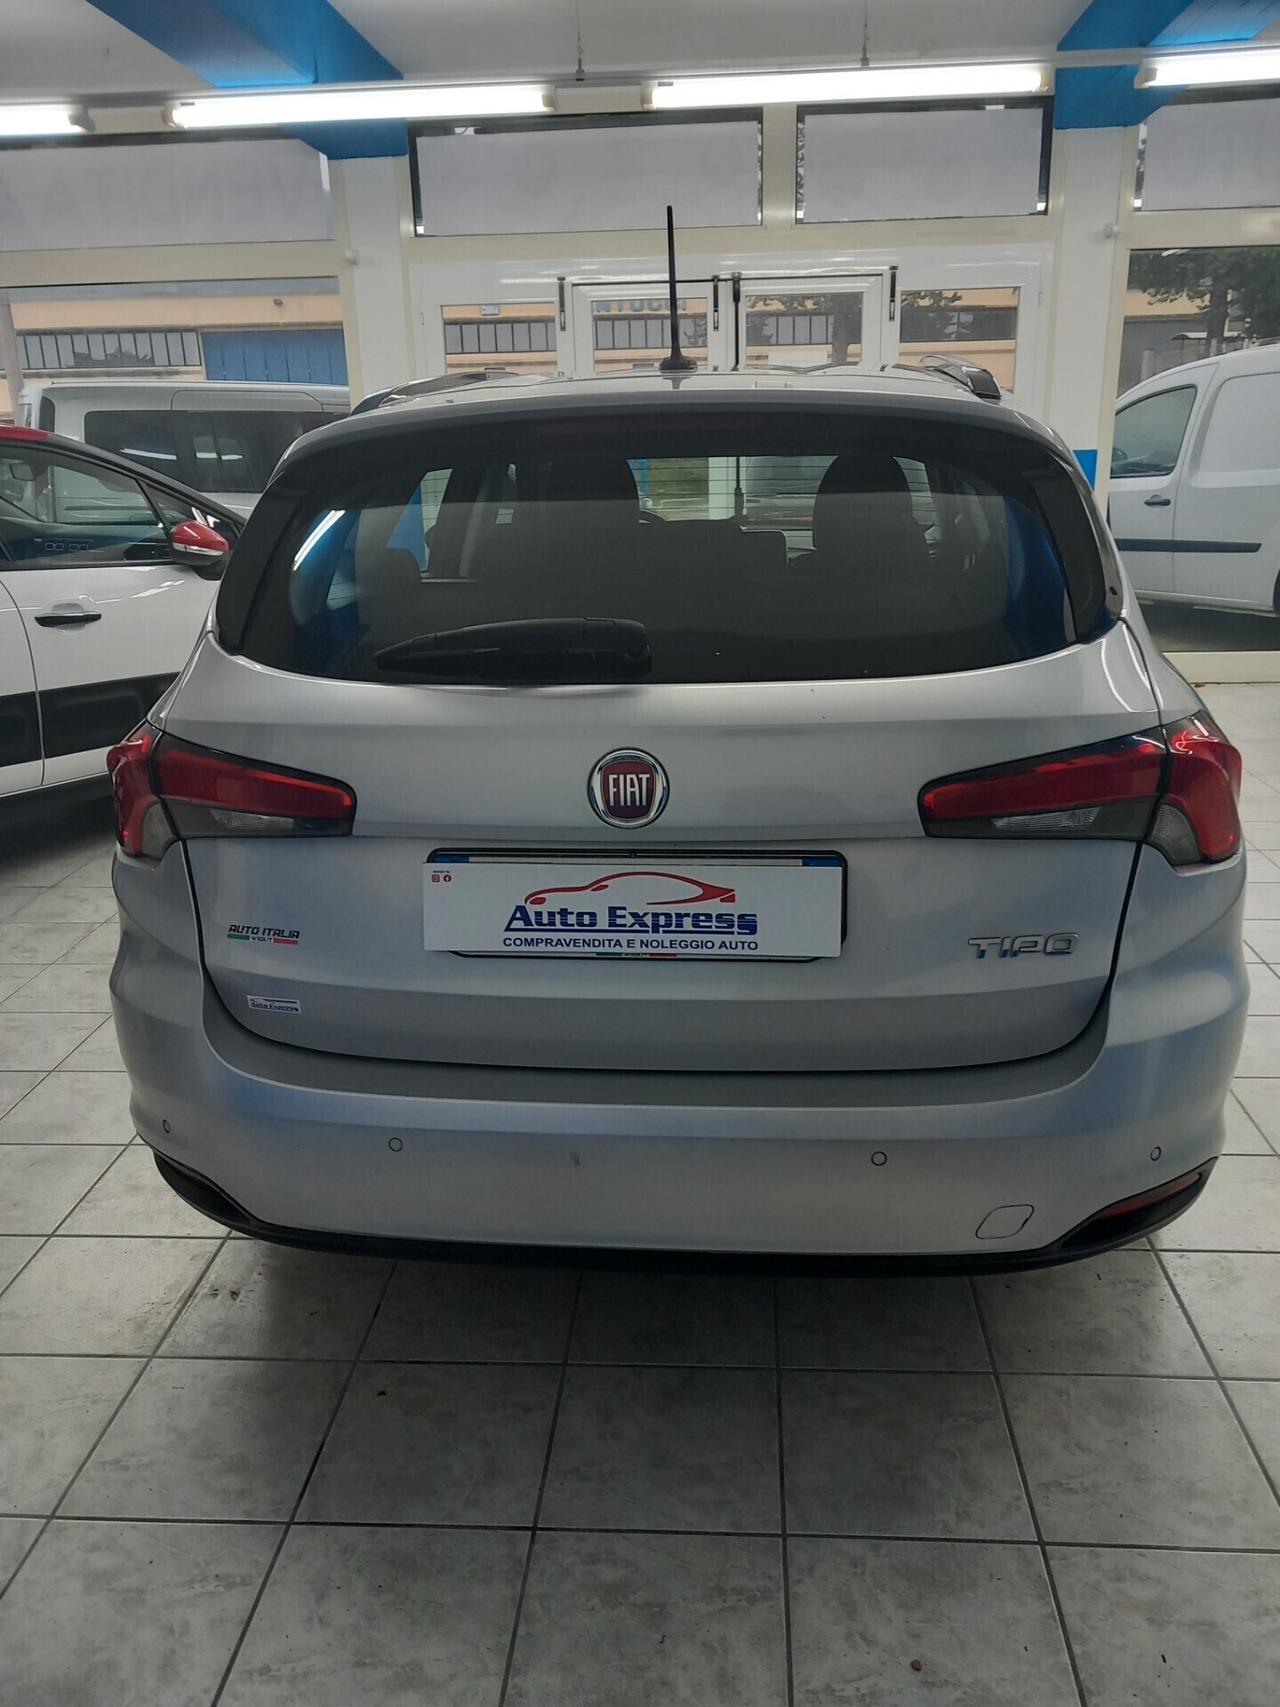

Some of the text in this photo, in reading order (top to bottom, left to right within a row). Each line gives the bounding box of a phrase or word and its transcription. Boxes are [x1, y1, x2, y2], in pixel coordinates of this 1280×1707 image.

[608, 773, 651, 807] FIAT
[229, 923, 300, 939] AUTO ITALIA
[505, 904, 759, 936] Auto Express
[502, 937, 759, 951] COMPRAVENDITA E NOLEGGIO AUTO
[967, 932, 1080, 960] TIPO
